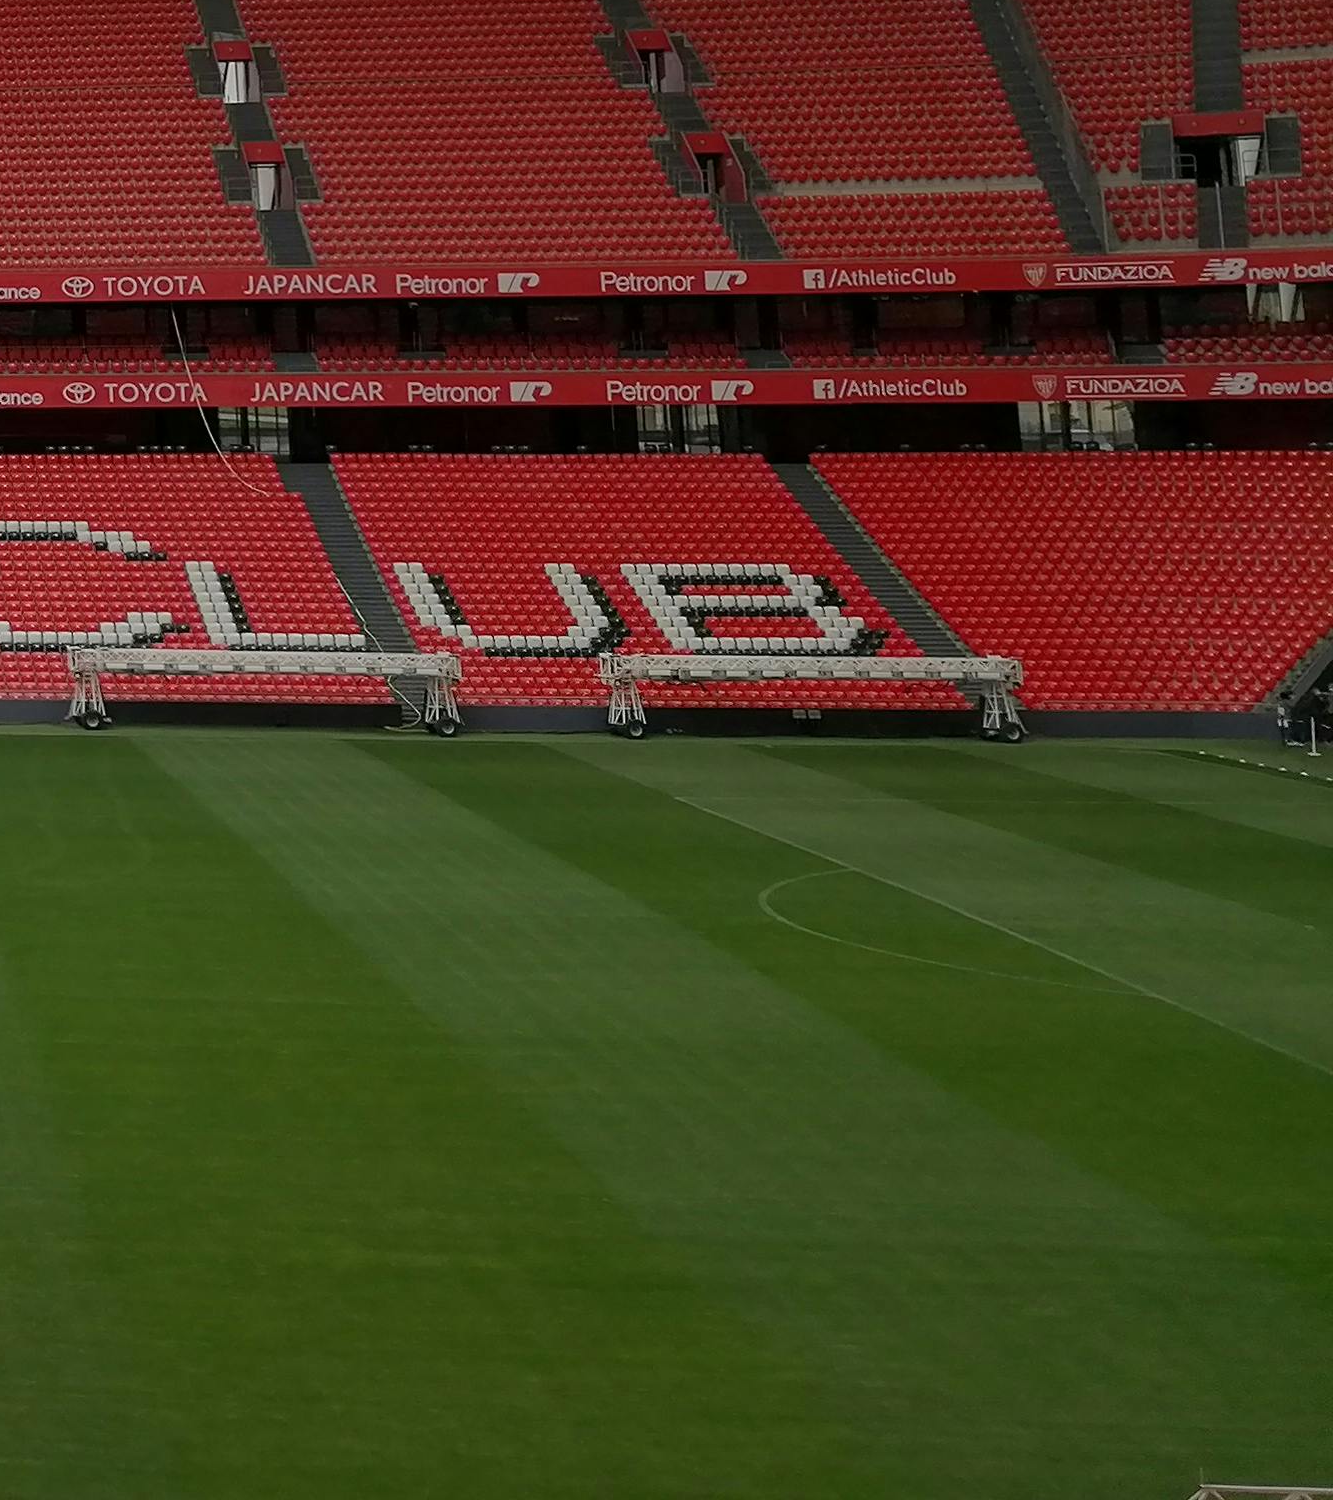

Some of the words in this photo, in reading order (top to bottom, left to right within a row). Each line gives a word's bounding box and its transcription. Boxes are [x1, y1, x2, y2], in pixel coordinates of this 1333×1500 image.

[600, 272, 695, 292] Petronor
[829, 268, 955, 288] /AthleticClub
[1055, 265, 1175, 282] FUNDAZIOA
[1249, 267, 1289, 279] new
[103, 276, 205, 296] TOYOTA
[244, 274, 377, 294] JAPANCAR
[396, 274, 488, 294] Petronor
[103, 381, 208, 403] TOYOTA
[250, 382, 384, 402] JAPANCAR
[408, 382, 500, 403] Petronor
[607, 381, 701, 401] Petronor
[839, 379, 966, 398] /AthleticClub
[1066, 378, 1185, 395] FUNDAZIOA
[1259, 382, 1300, 394] new
